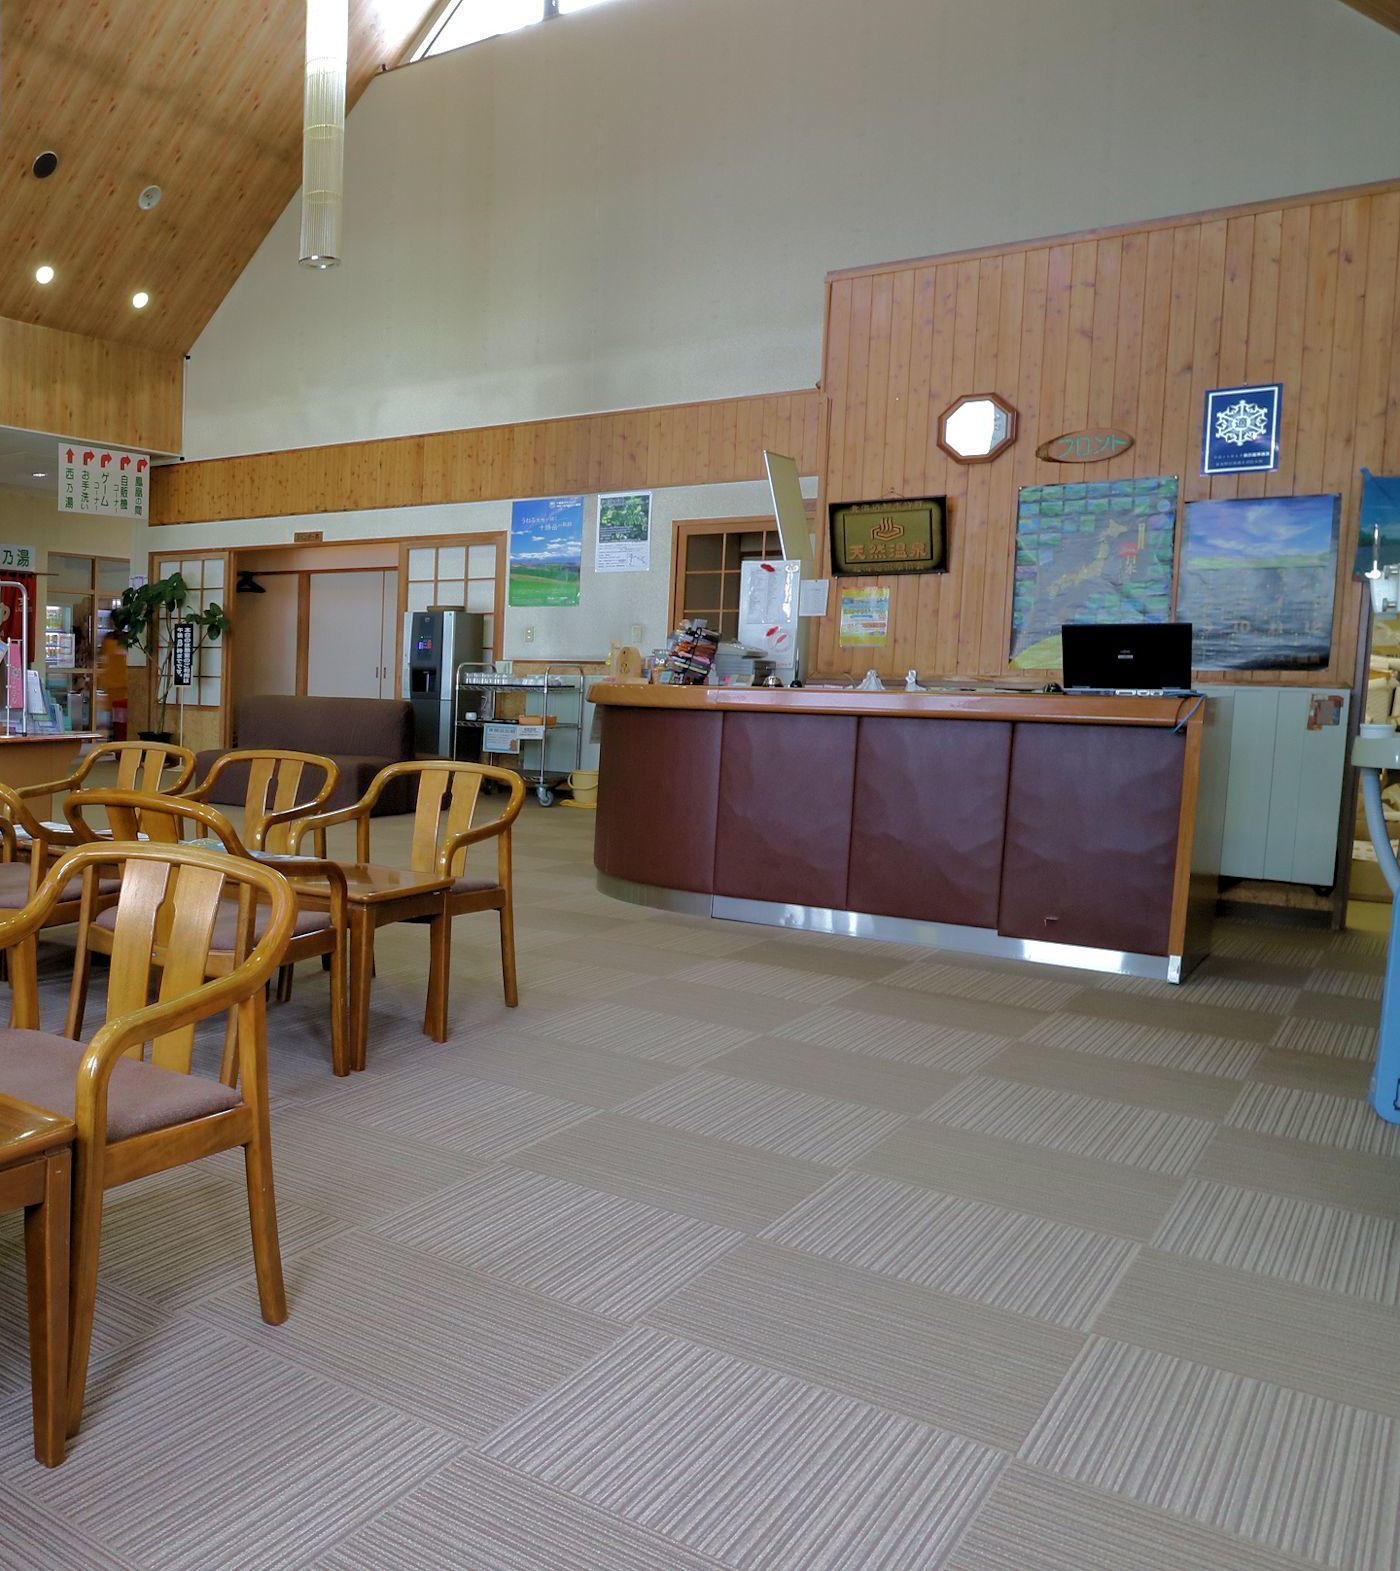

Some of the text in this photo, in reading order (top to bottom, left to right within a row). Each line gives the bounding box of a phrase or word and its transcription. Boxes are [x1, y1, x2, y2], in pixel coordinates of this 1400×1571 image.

[1058, 433, 1127, 458] フロント
[65, 467, 74, 509] 西乃湯
[80, 470, 90, 510] お手洗い
[101, 472, 109, 507] ゲーム
[120, 475, 128, 510] 自販機
[849, 542, 927, 560] 天然温泉
